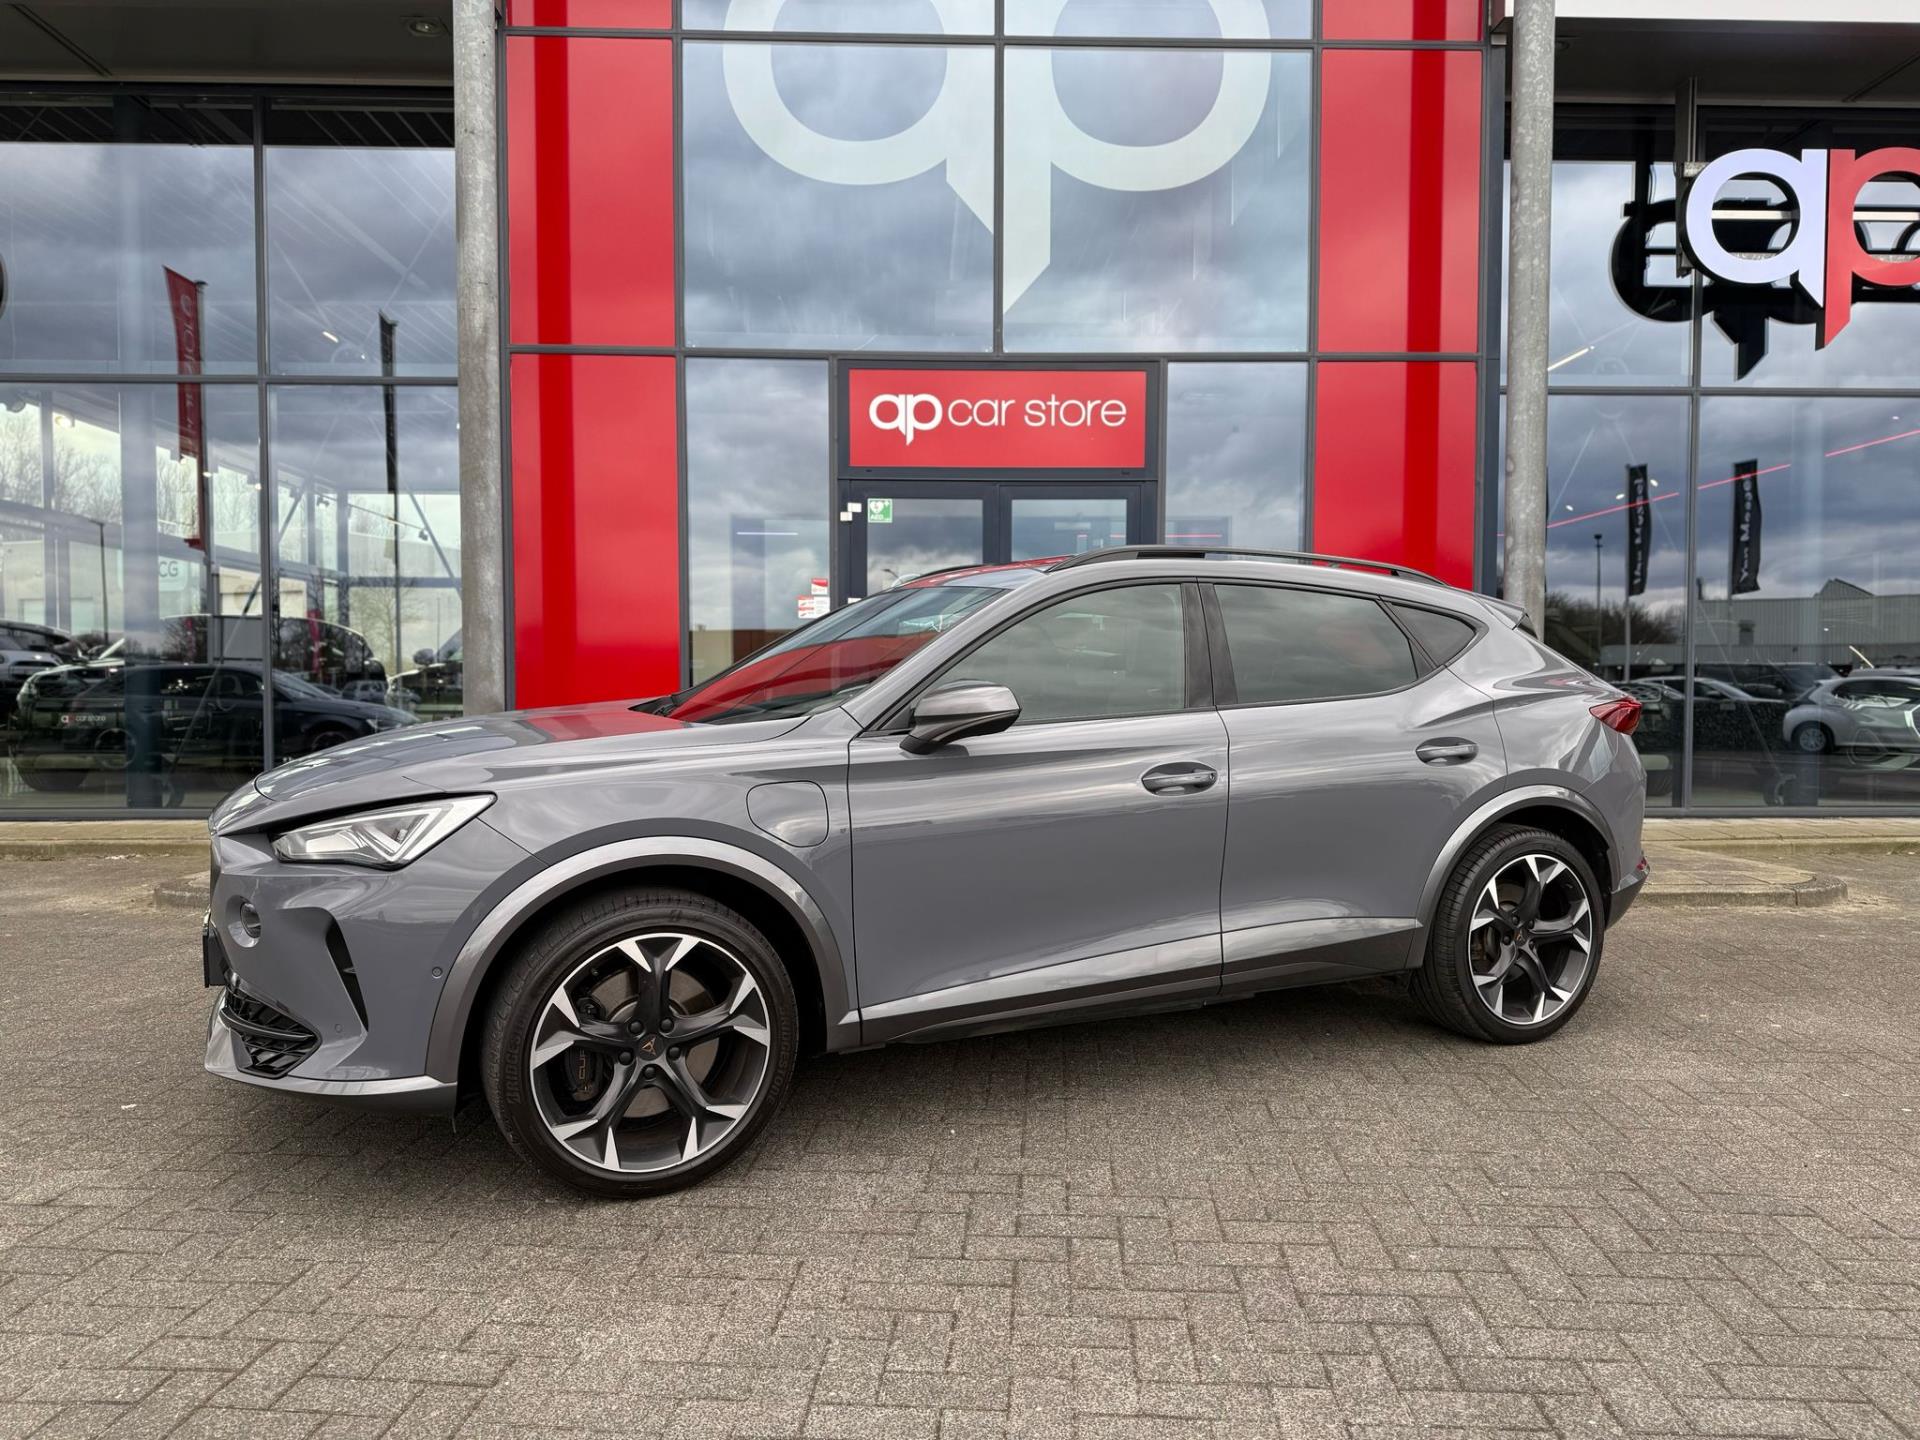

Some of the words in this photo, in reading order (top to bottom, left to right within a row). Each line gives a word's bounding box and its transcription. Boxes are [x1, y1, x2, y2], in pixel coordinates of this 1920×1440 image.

[1686, 147, 1920, 347] ap
[869, 393, 943, 445] ap
[948, 398, 1016, 427] car
[1024, 394, 1127, 427] store
